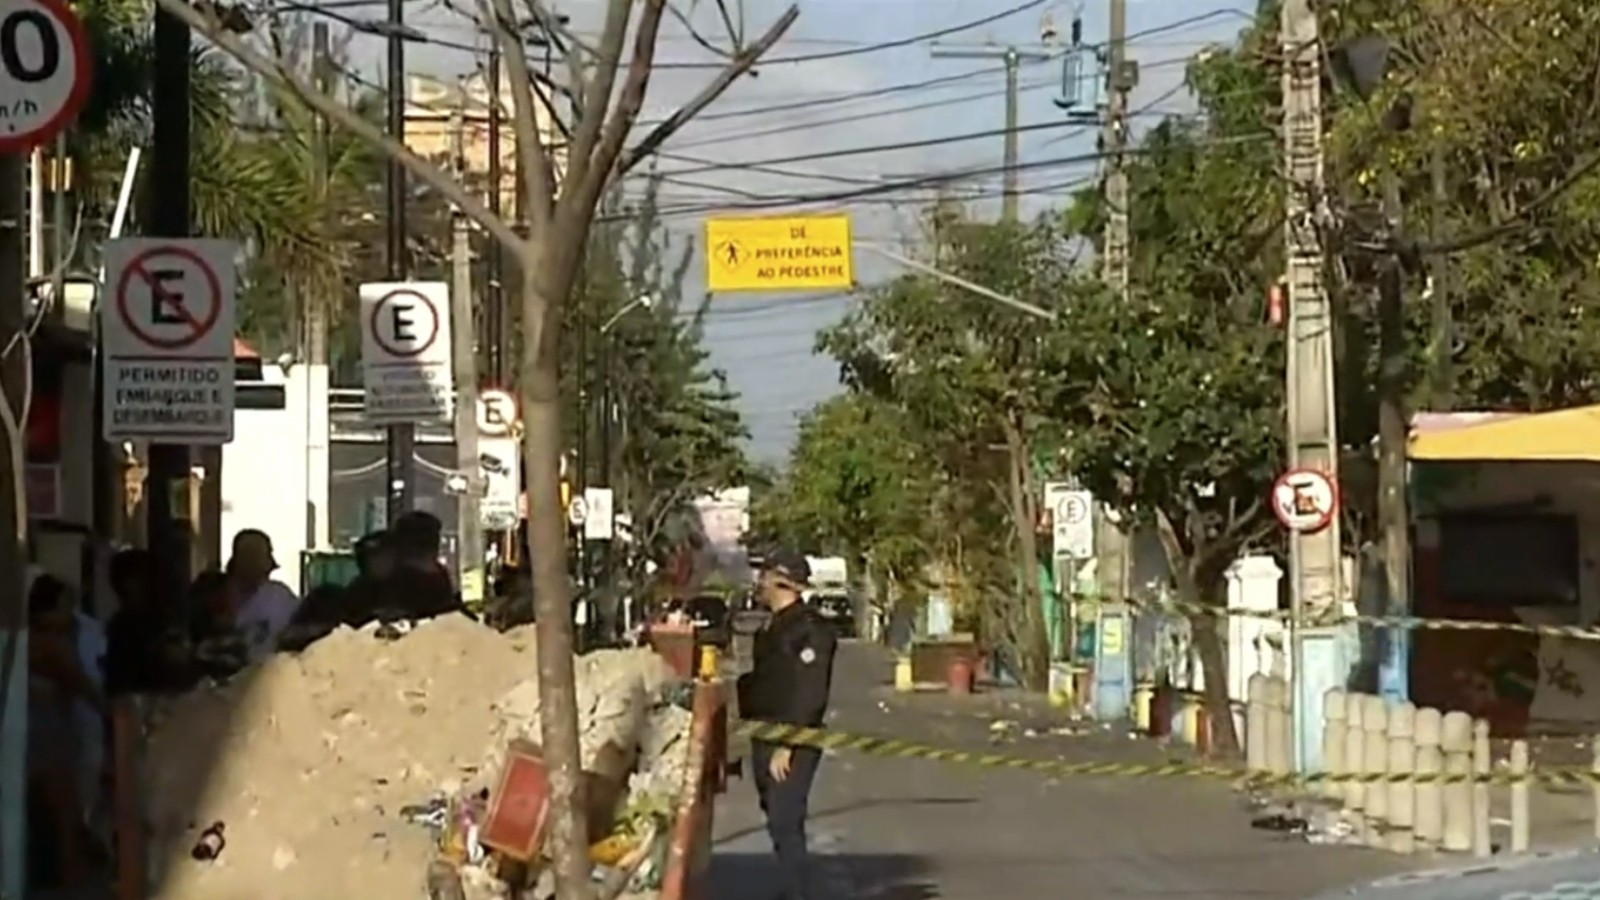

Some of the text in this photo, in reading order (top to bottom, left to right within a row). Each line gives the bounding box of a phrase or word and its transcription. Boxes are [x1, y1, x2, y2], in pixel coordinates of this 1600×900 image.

[757, 266, 844, 279] AO PEDESTRE
[152, 270, 186, 324] E
[392, 305, 417, 341] E
[119, 366, 220, 383] PERMITIDO
